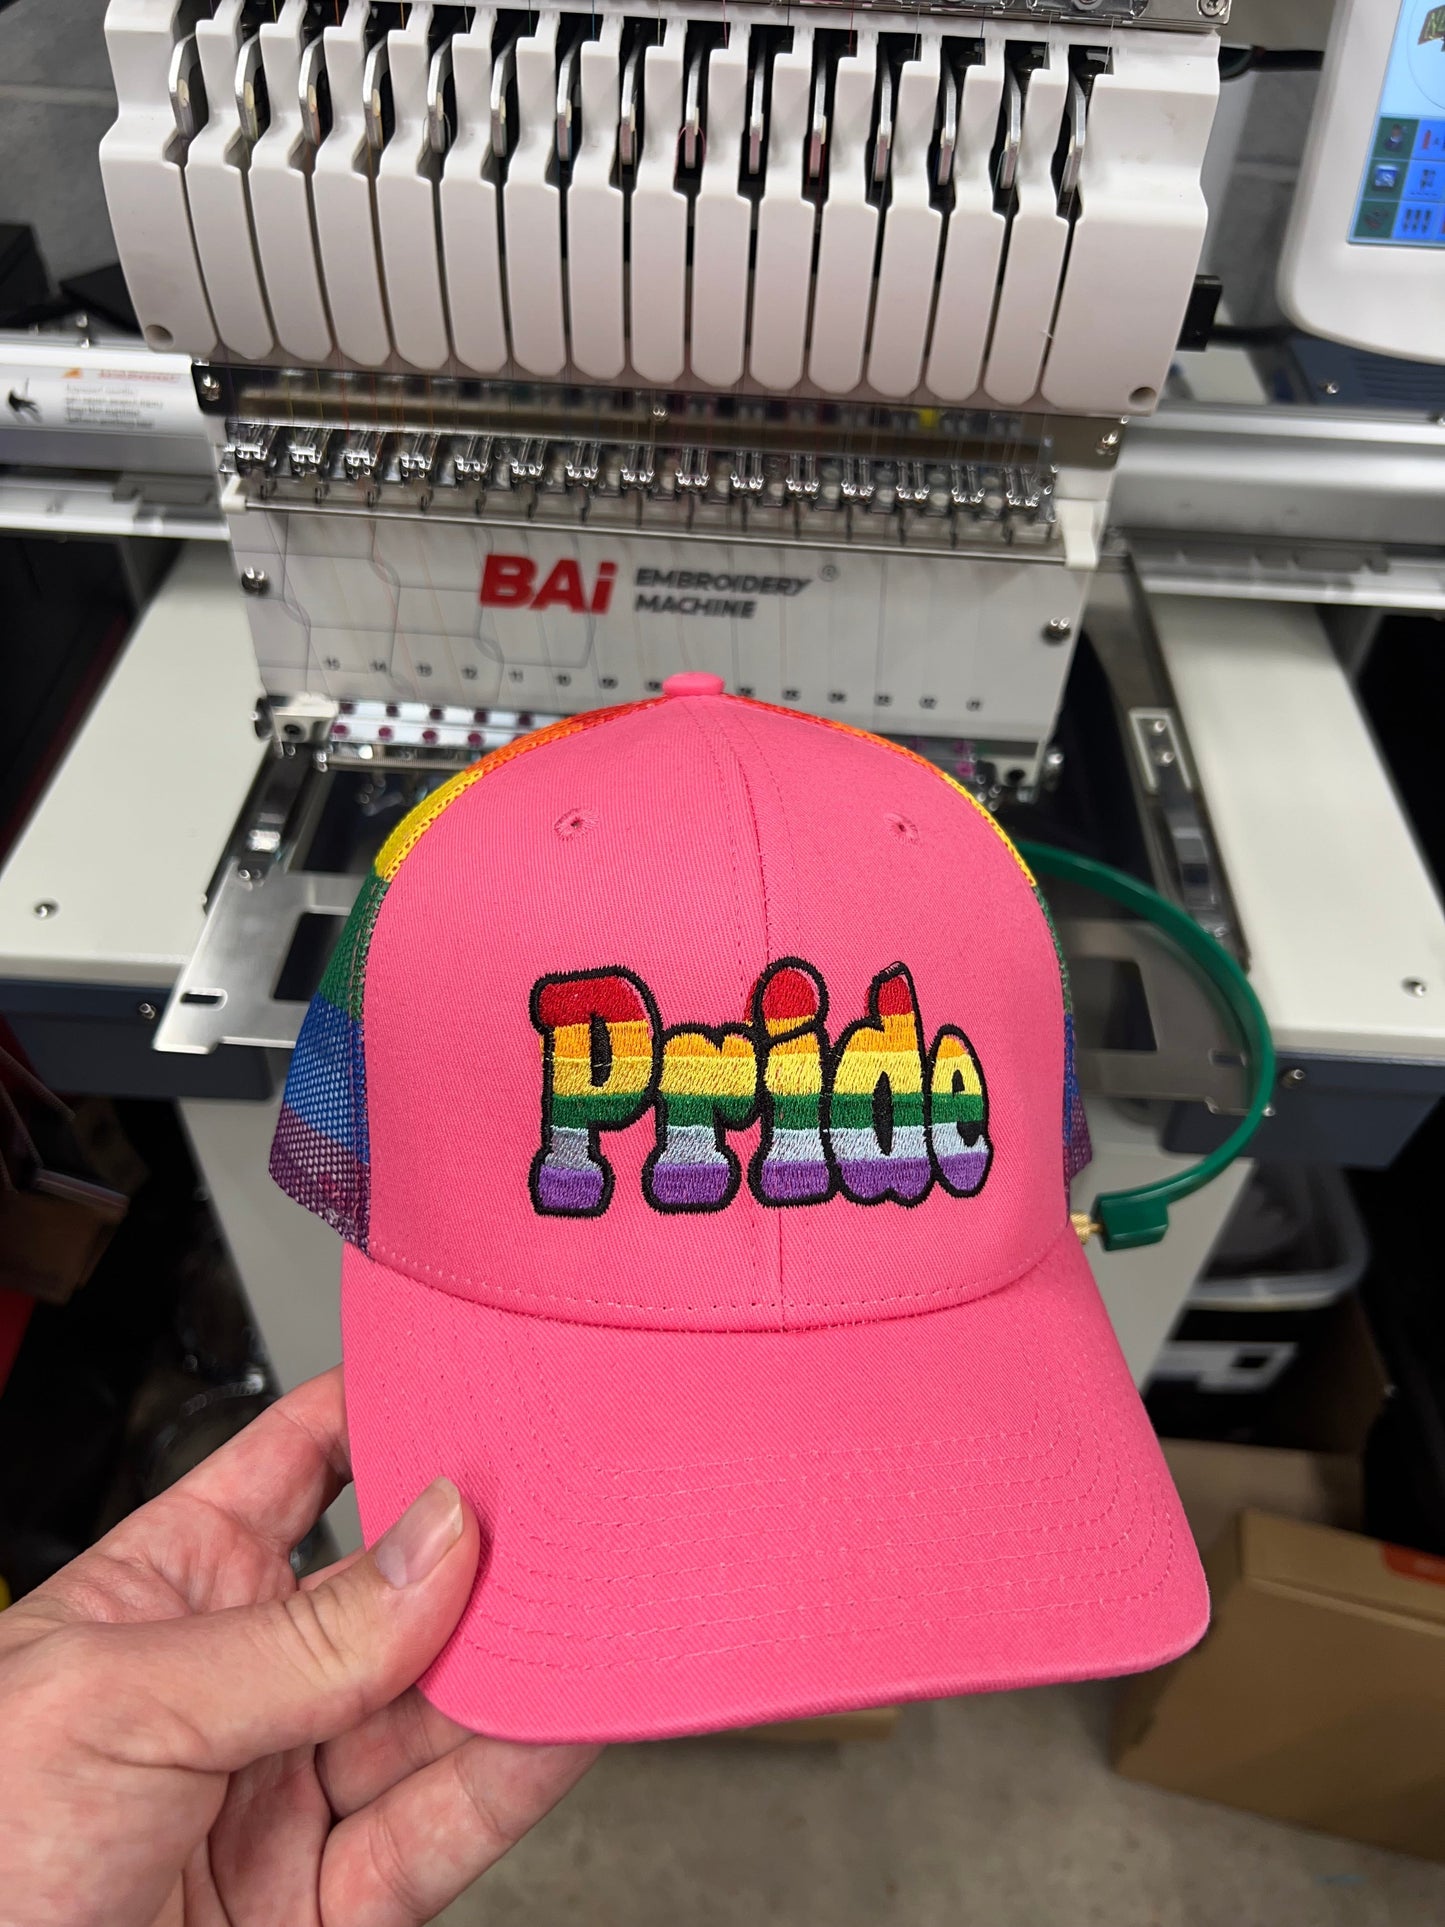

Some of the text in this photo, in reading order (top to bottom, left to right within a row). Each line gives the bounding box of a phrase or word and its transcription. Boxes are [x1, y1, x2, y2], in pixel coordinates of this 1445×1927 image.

[480, 554, 618, 615] BAi
[635, 567, 814, 597] EMBROIDERY
[634, 594, 758, 619] MACHINE
[528, 956, 994, 1219] Pride
